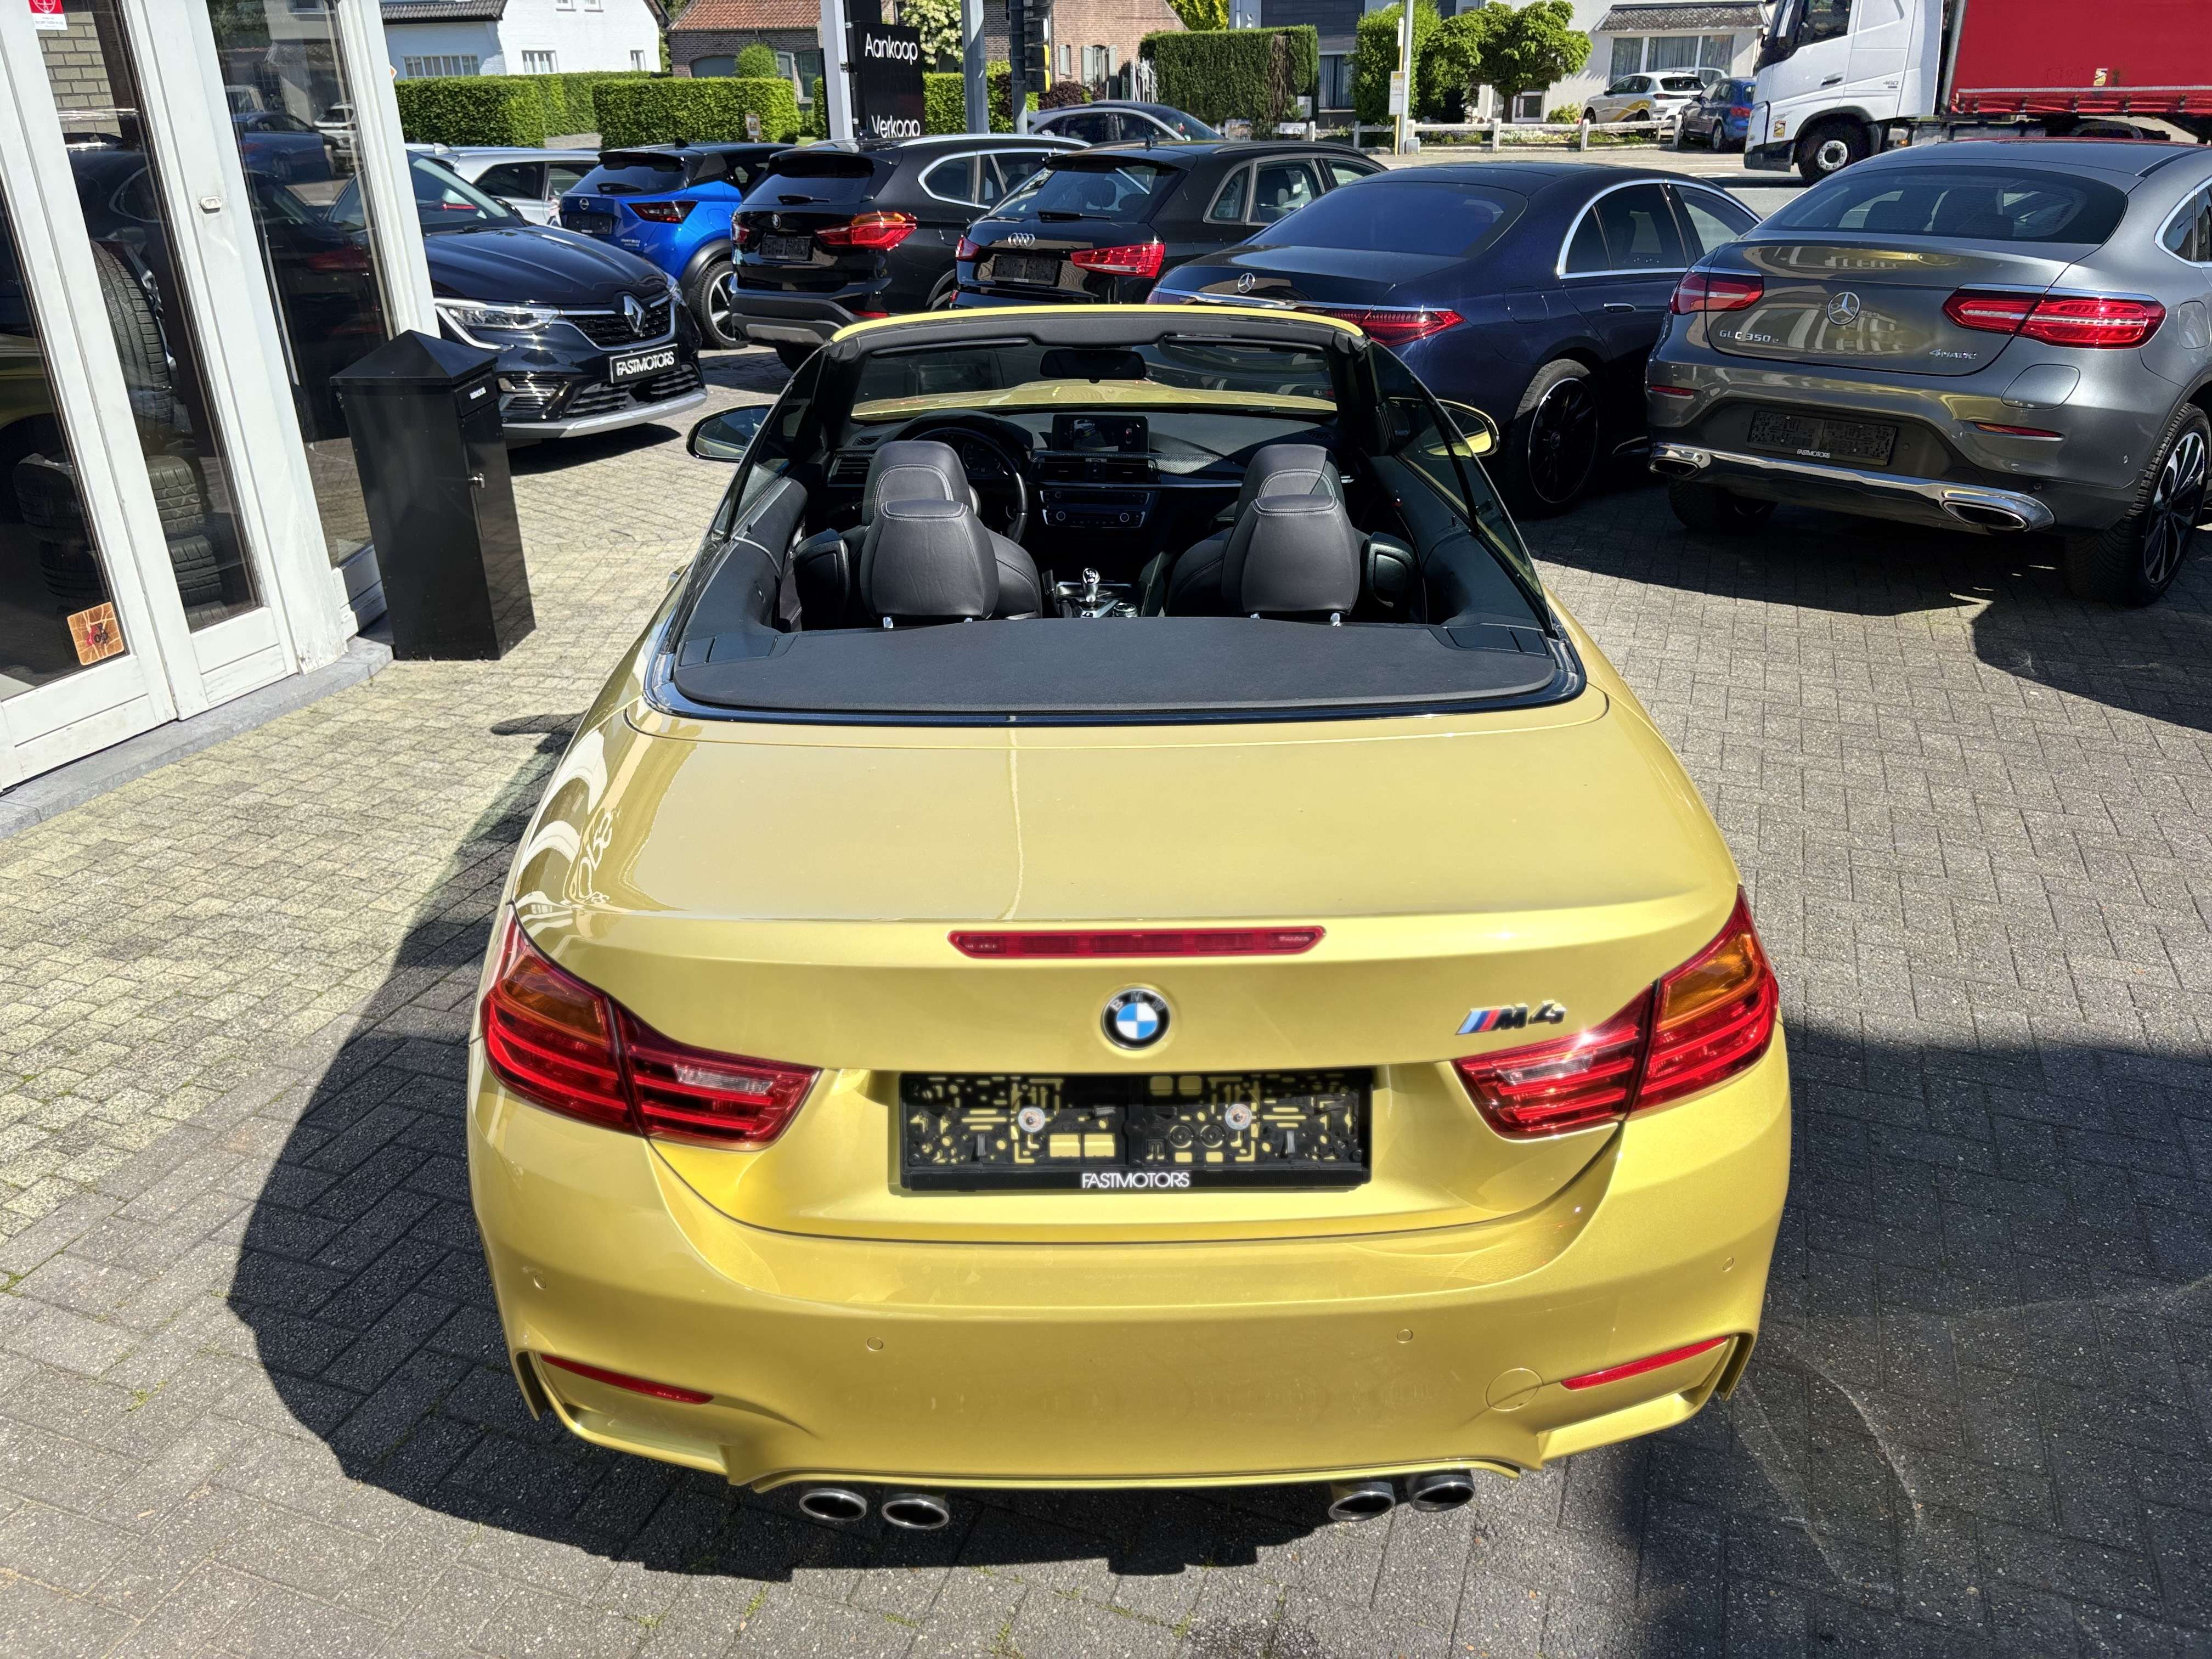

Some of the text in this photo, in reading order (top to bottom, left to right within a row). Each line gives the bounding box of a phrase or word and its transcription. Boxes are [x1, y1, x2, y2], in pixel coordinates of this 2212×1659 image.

[865, 33, 918, 65] Aankoop
[1719, 330, 1743, 340] GLC
[1746, 332, 1771, 343] 350
[1929, 348, 1977, 359] 4MATIC
[616, 351, 675, 377] FASTMOTORS
[1796, 448, 1831, 459] FASTMOTORS
[1109, 991, 1166, 1012] BMW
[1488, 999, 1567, 1030] M4
[1081, 1172, 1190, 1188] FASTMOTORS
